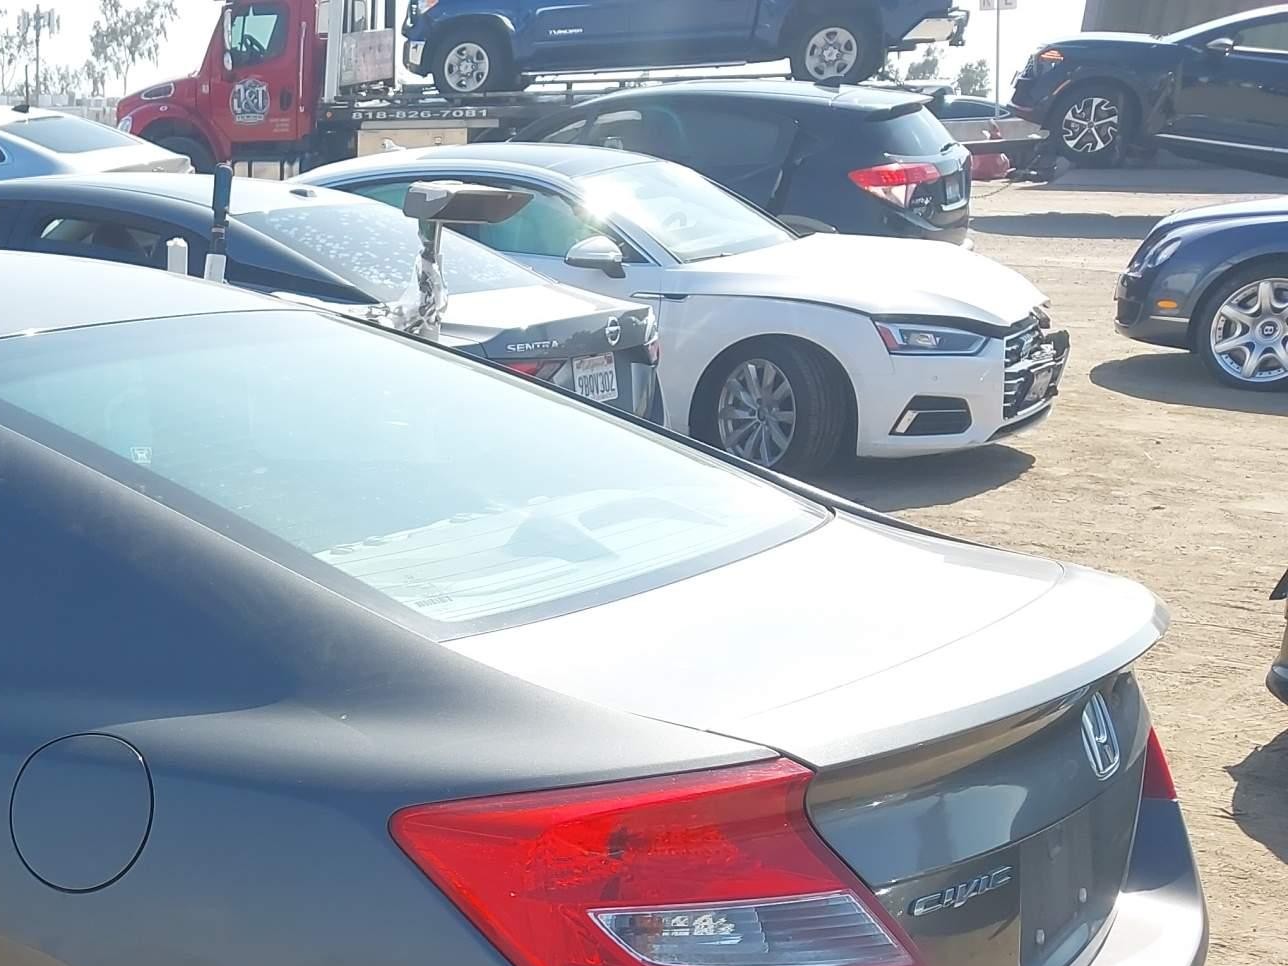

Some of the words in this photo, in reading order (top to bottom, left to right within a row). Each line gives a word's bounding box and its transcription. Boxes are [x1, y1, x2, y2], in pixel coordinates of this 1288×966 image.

[351, 109, 488, 120] 818-826-7081
[506, 340, 560, 353] SENTRA
[910, 865, 1013, 917] CIVIC
